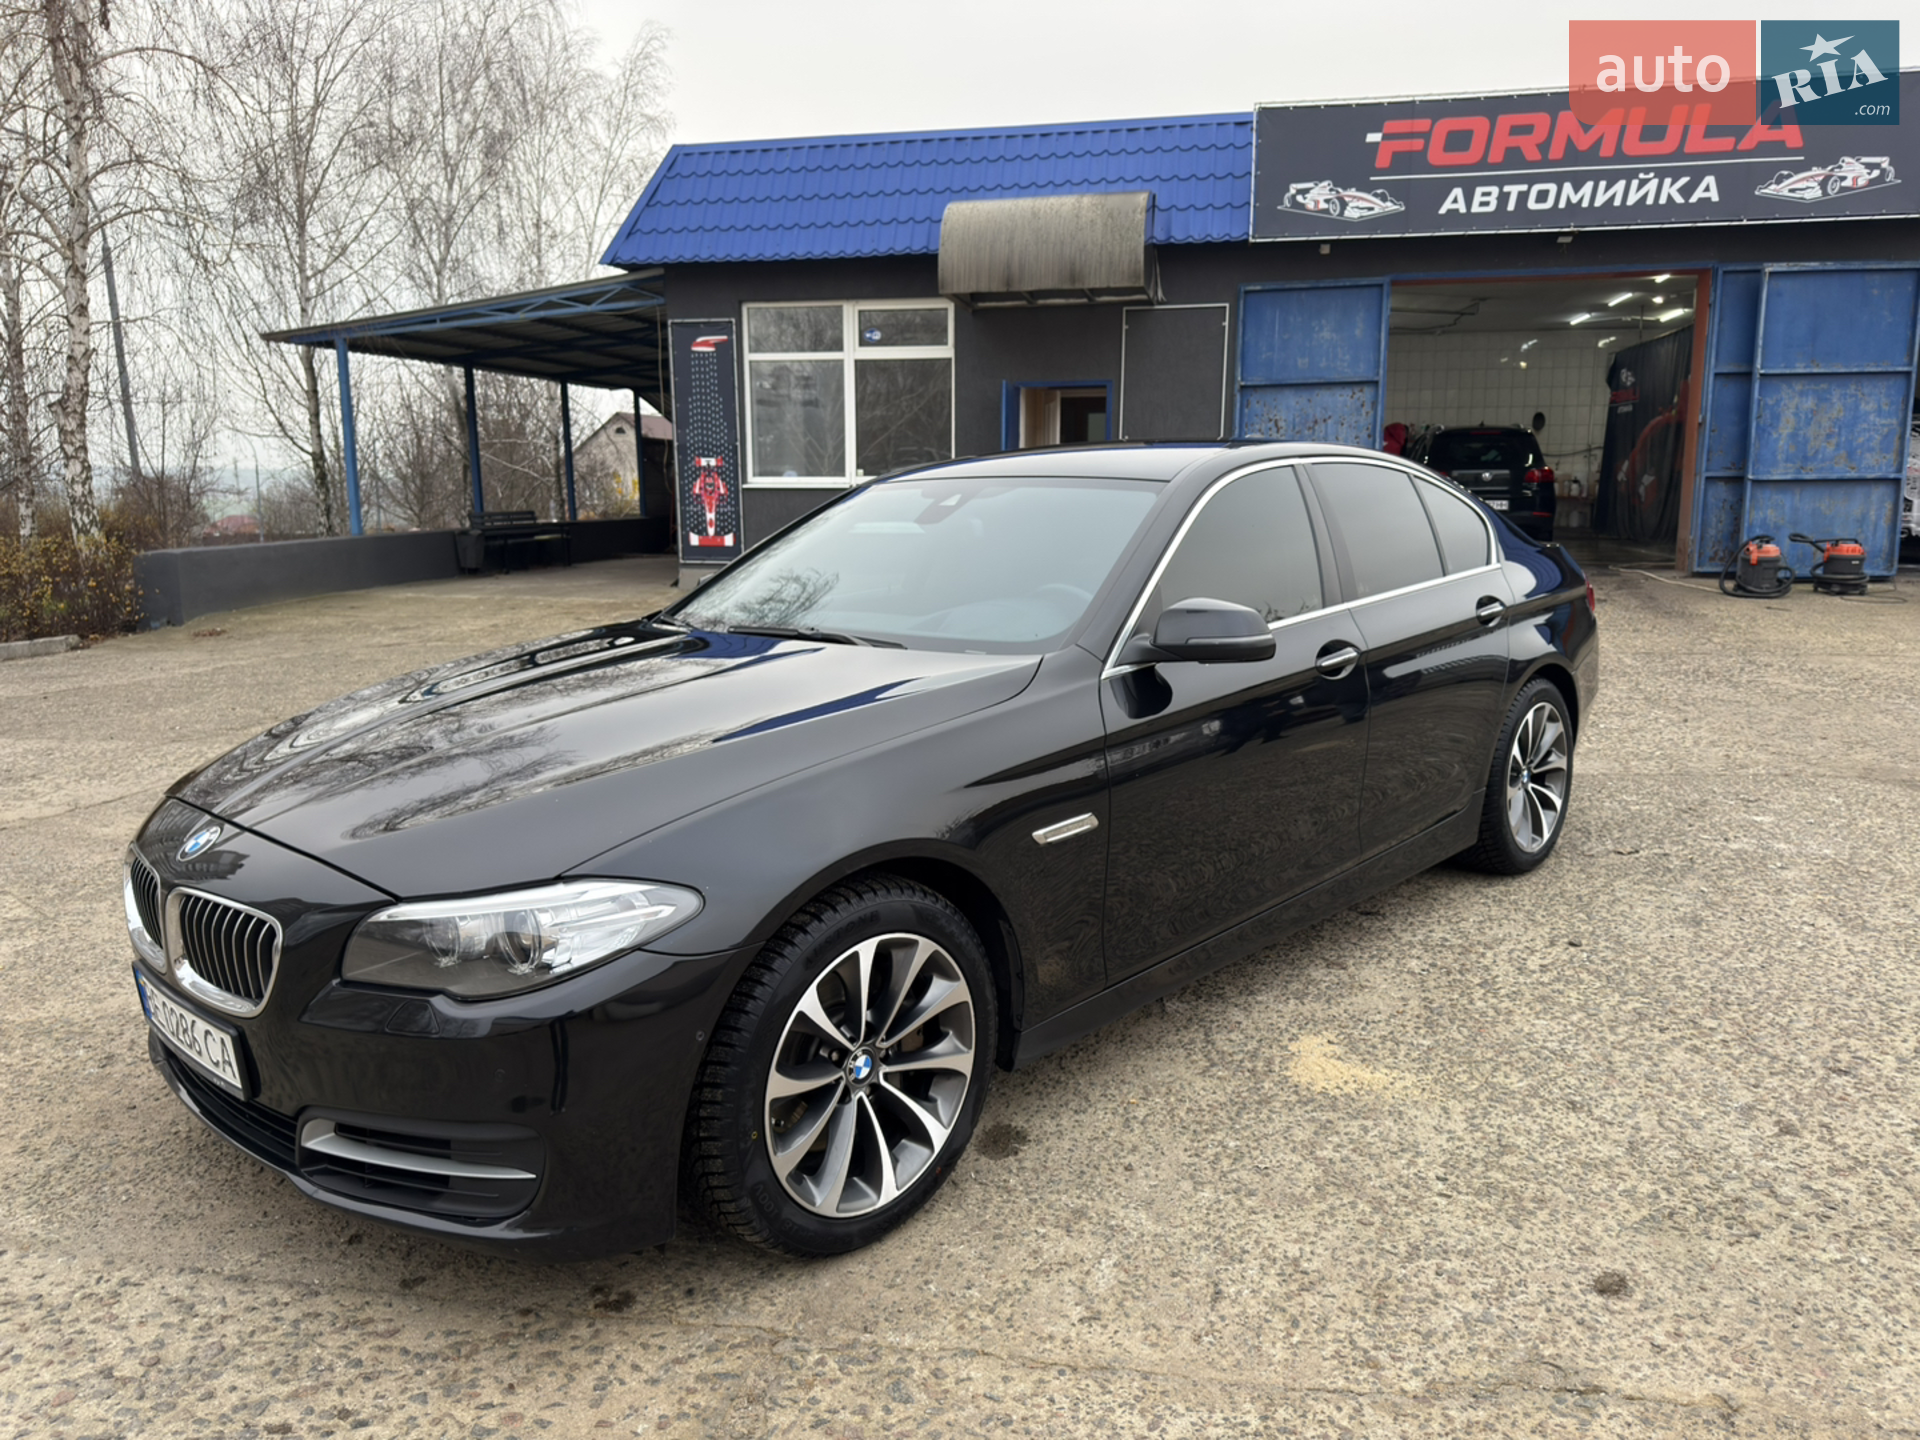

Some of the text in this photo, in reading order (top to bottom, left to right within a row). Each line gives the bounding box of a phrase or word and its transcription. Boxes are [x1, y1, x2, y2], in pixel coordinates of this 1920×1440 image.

[1374, 99, 1804, 169] FORMULA
[1438, 172, 1720, 214] АВТОМИЙКА
[162, 1000, 202, 1057] 0286
[204, 1029, 238, 1080] CA
